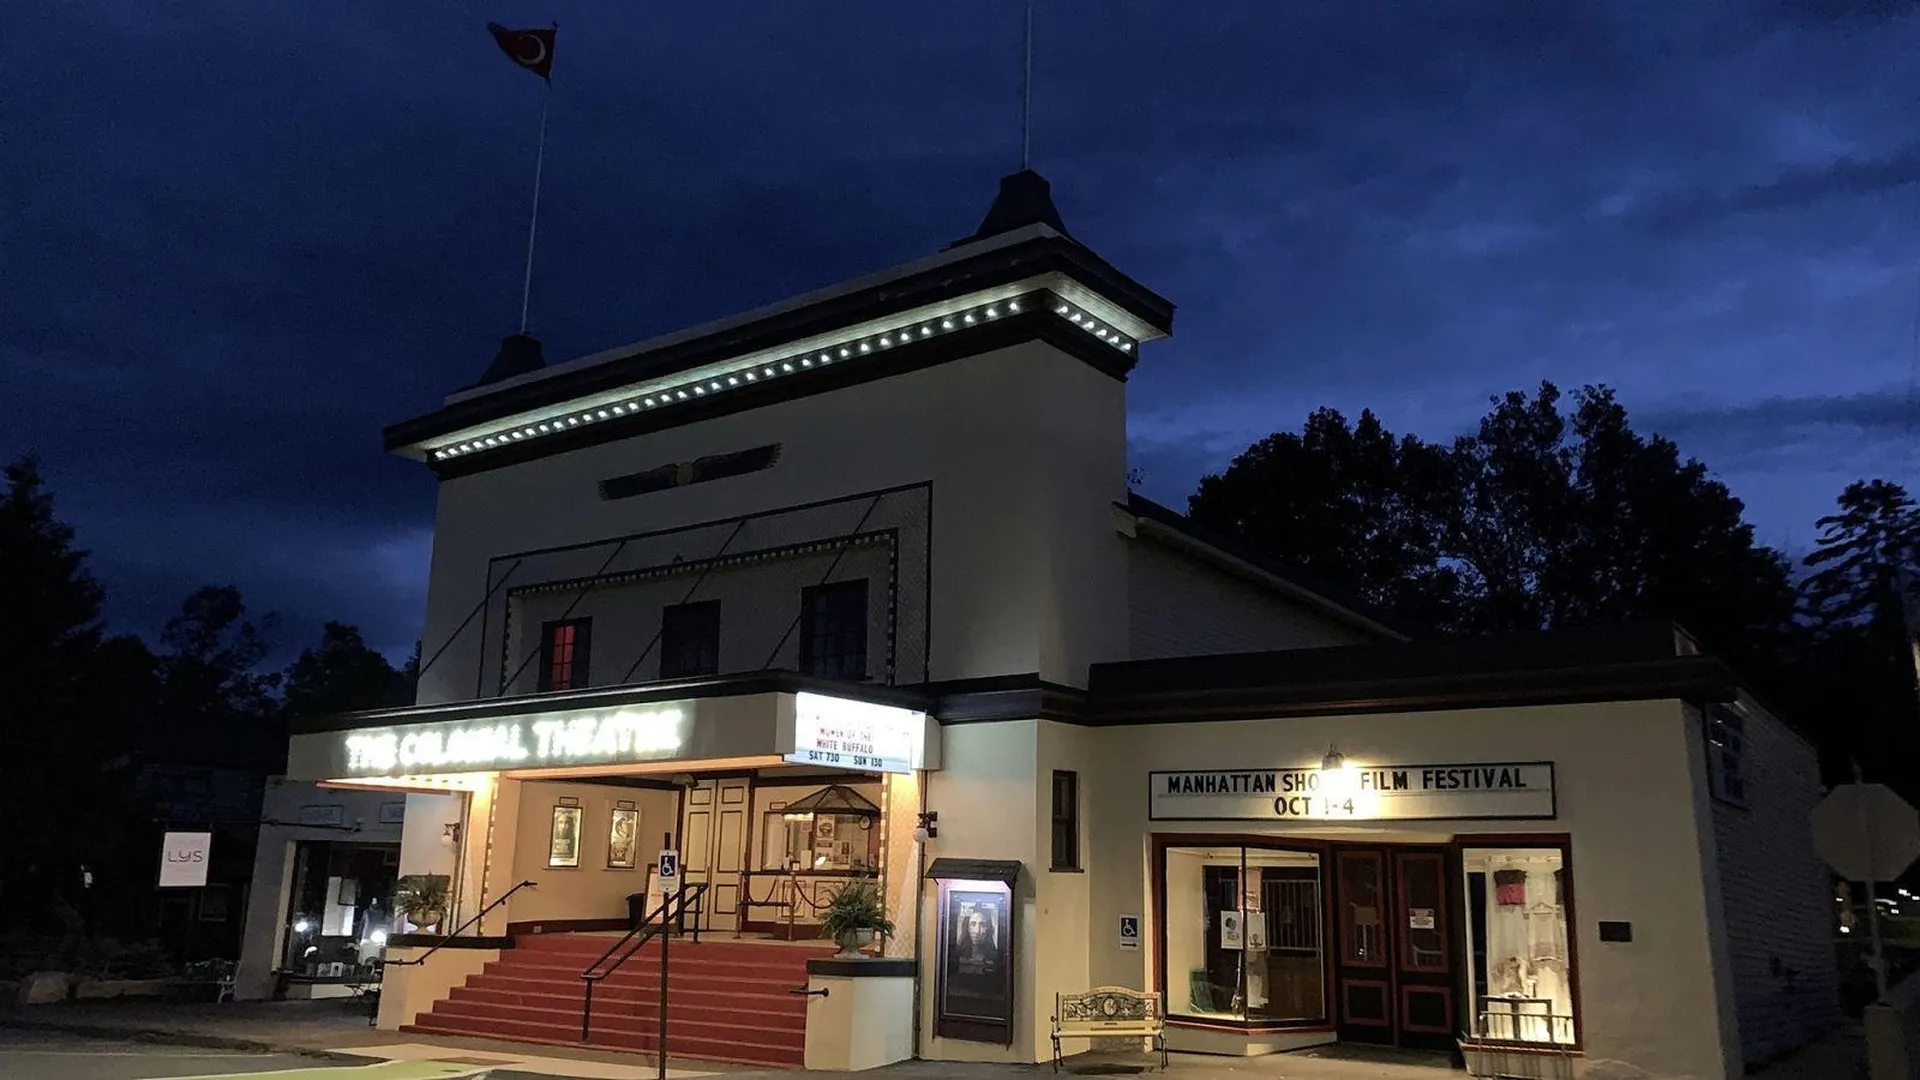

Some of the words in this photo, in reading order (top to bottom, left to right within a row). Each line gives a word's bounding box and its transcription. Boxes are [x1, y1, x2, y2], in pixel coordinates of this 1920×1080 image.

[816, 738, 838, 751] WHITE
[842, 741, 874, 754] BUFFALO
[809, 750, 822, 761] SAT
[826, 751, 840, 763] 730
[853, 755, 867, 766] SUN
[871, 757, 883, 768] 130
[1168, 774, 1276, 793] MANHATTAN
[1282, 773, 1337, 792] SHO
[1360, 771, 1409, 790] FILM
[1422, 768, 1527, 790] FESTIVAL
[1274, 796, 1312, 816] OCT
